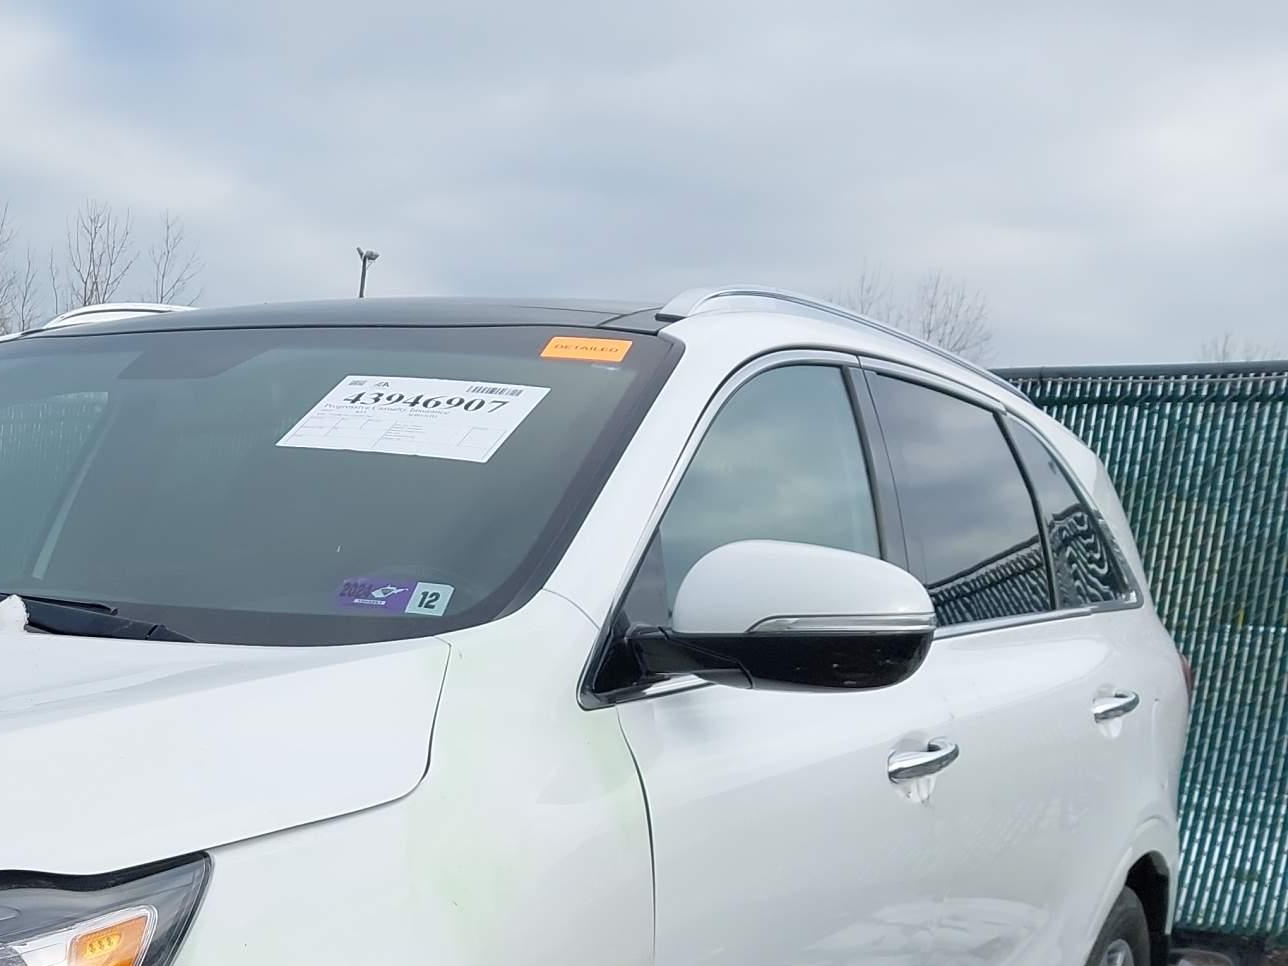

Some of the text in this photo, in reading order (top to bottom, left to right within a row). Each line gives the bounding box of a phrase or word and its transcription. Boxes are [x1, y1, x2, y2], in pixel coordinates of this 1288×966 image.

[554, 342, 620, 353] DETAILED
[343, 391, 509, 414] 43946907
[417, 591, 441, 609] 12
